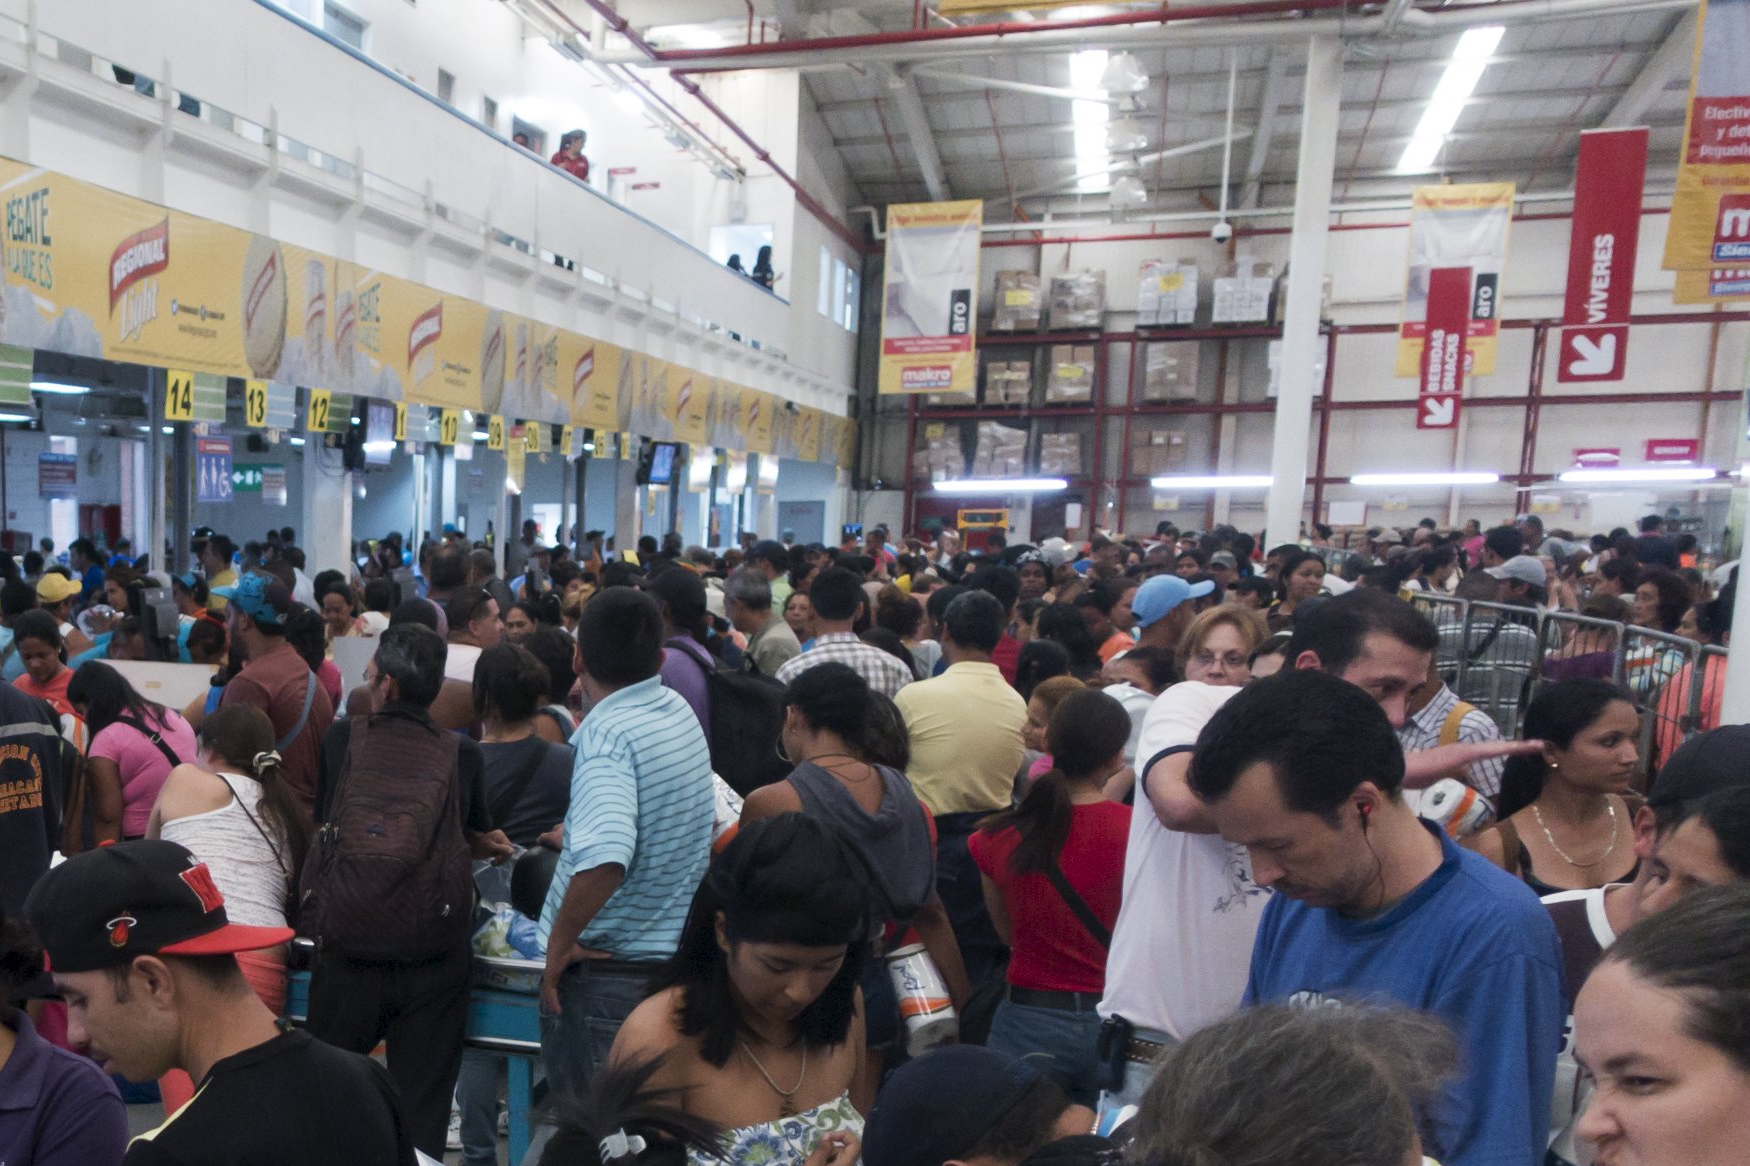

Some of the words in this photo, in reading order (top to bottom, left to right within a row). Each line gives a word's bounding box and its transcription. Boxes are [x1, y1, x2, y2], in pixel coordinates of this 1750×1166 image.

[113, 236, 166, 292] REGIONAL
[1583, 233, 1615, 325] VÍVERES
[951, 301, 968, 334] aro
[1476, 285, 1493, 318] aro
[1427, 328, 1445, 392] BEBIDAS
[1441, 332, 1460, 392] SNACKS
[170, 378, 192, 417] 14
[248, 388, 265, 423] 13
[311, 396, 328, 429] 12
[444, 414, 457, 443] 10
